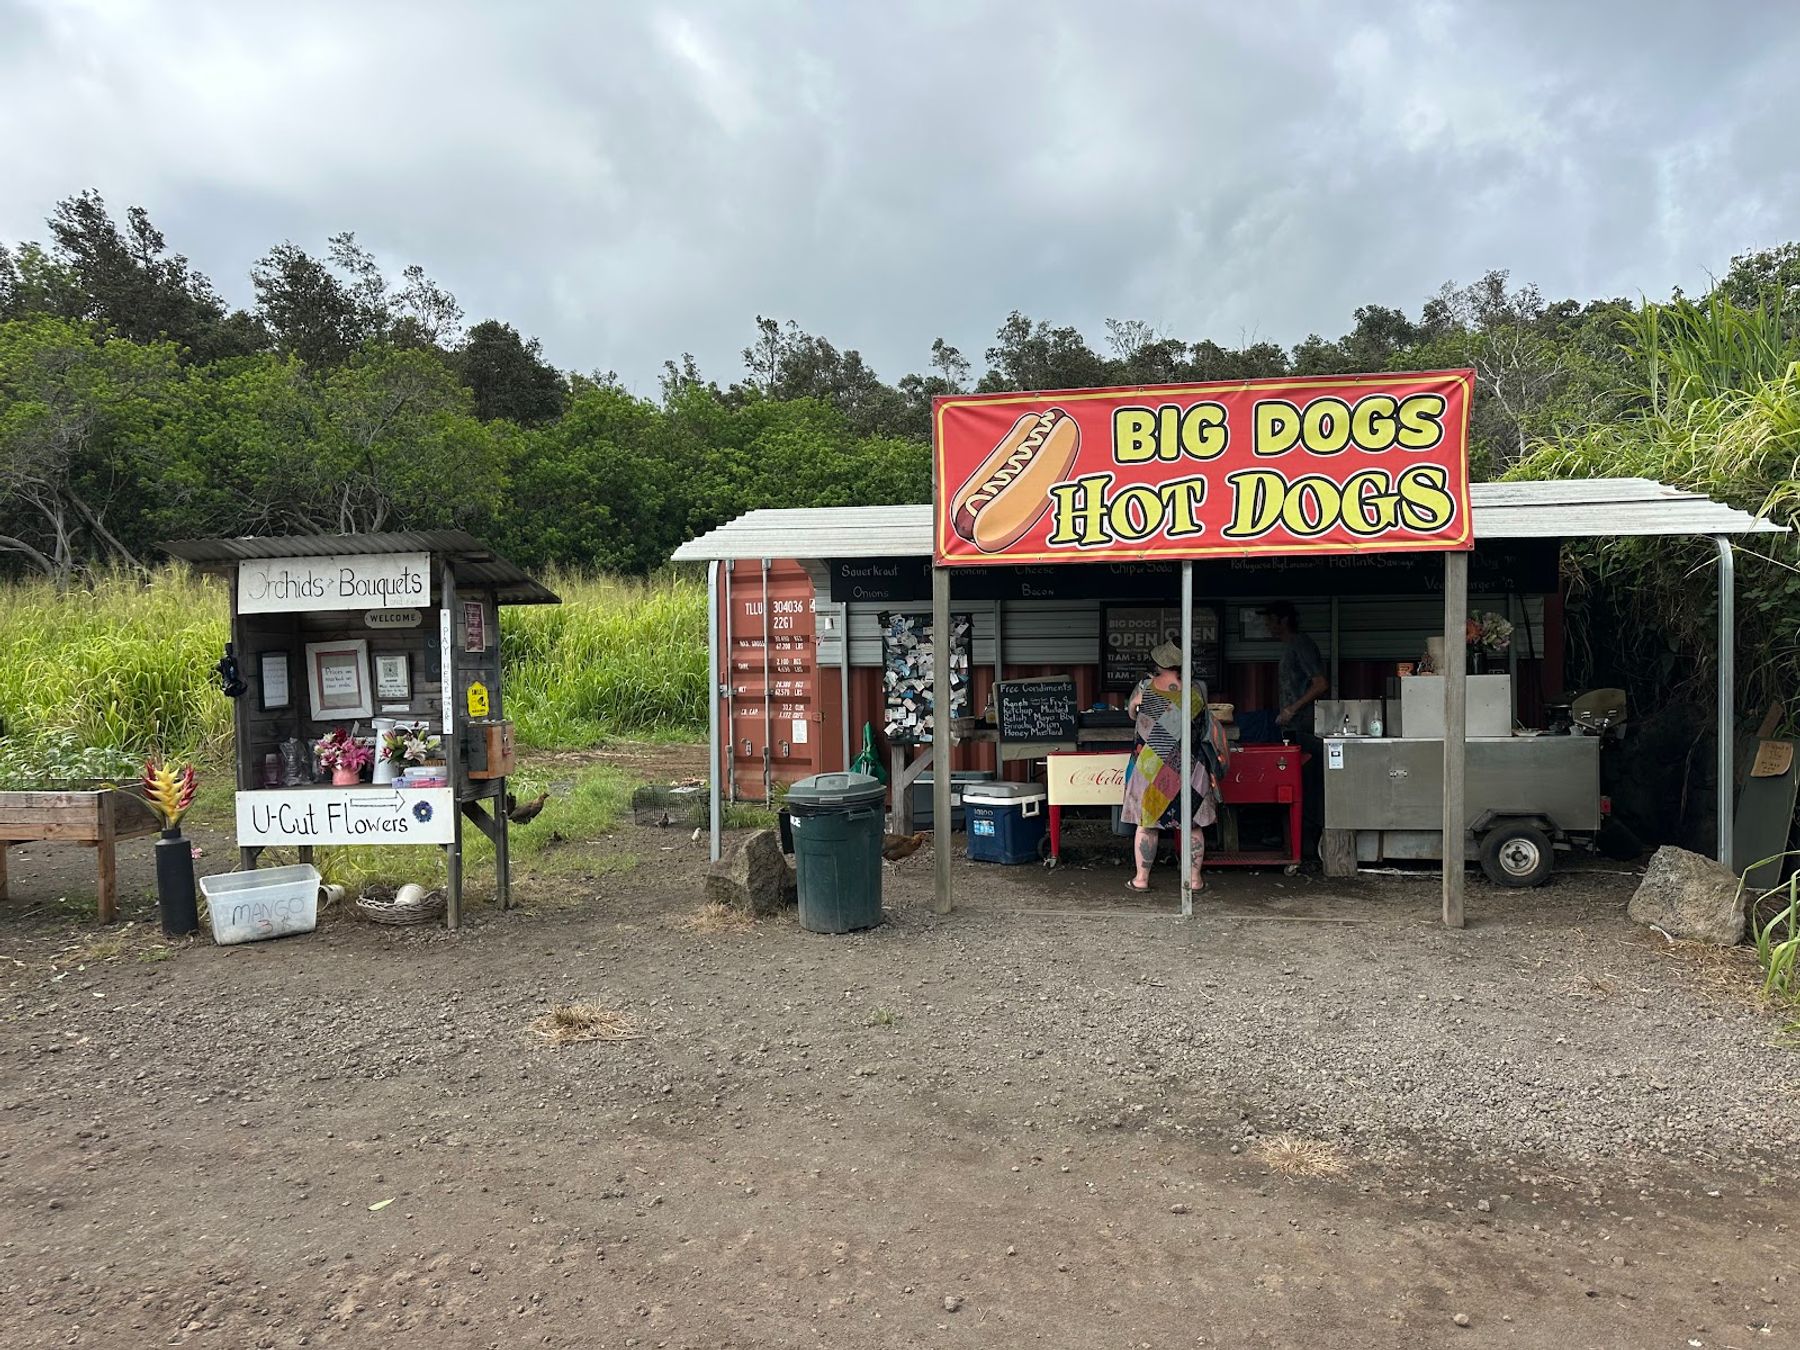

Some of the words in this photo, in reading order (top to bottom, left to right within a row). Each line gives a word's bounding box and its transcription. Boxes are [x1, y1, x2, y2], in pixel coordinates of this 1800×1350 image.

[1113, 402, 1229, 464] BIG
[1252, 393, 1447, 458] DOGS
[1049, 473, 1206, 547] HOT
[1222, 465, 1455, 539] DOGS
[247, 570, 325, 600] Orchids
[339, 566, 423, 607] Bouquets
[745, 602, 763, 615] TLLU
[773, 600, 803, 613] 304036
[370, 613, 416, 623] WELCOME
[773, 617, 793, 629] 22G1
[1109, 619, 1126, 629] BIG
[1128, 619, 1158, 629] DOGS
[1108, 632, 1158, 647] OPEN
[1164, 627, 1216, 641] OEN
[1000, 684, 1019, 693] Free
[1022, 682, 1072, 693] Condiments
[1003, 698, 1029, 707] Ranch
[1003, 706, 1033, 716] Ketchup
[1040, 704, 1069, 714] Mustard
[1003, 713, 1028, 722] Relish
[1033, 712, 1055, 724] Mayo
[1004, 729, 1030, 739] Honey
[1030, 727, 1064, 736] Mustard
[251, 802, 319, 835] U-Cut
[327, 802, 409, 835] Flowers
[232, 897, 305, 926] MANGO
